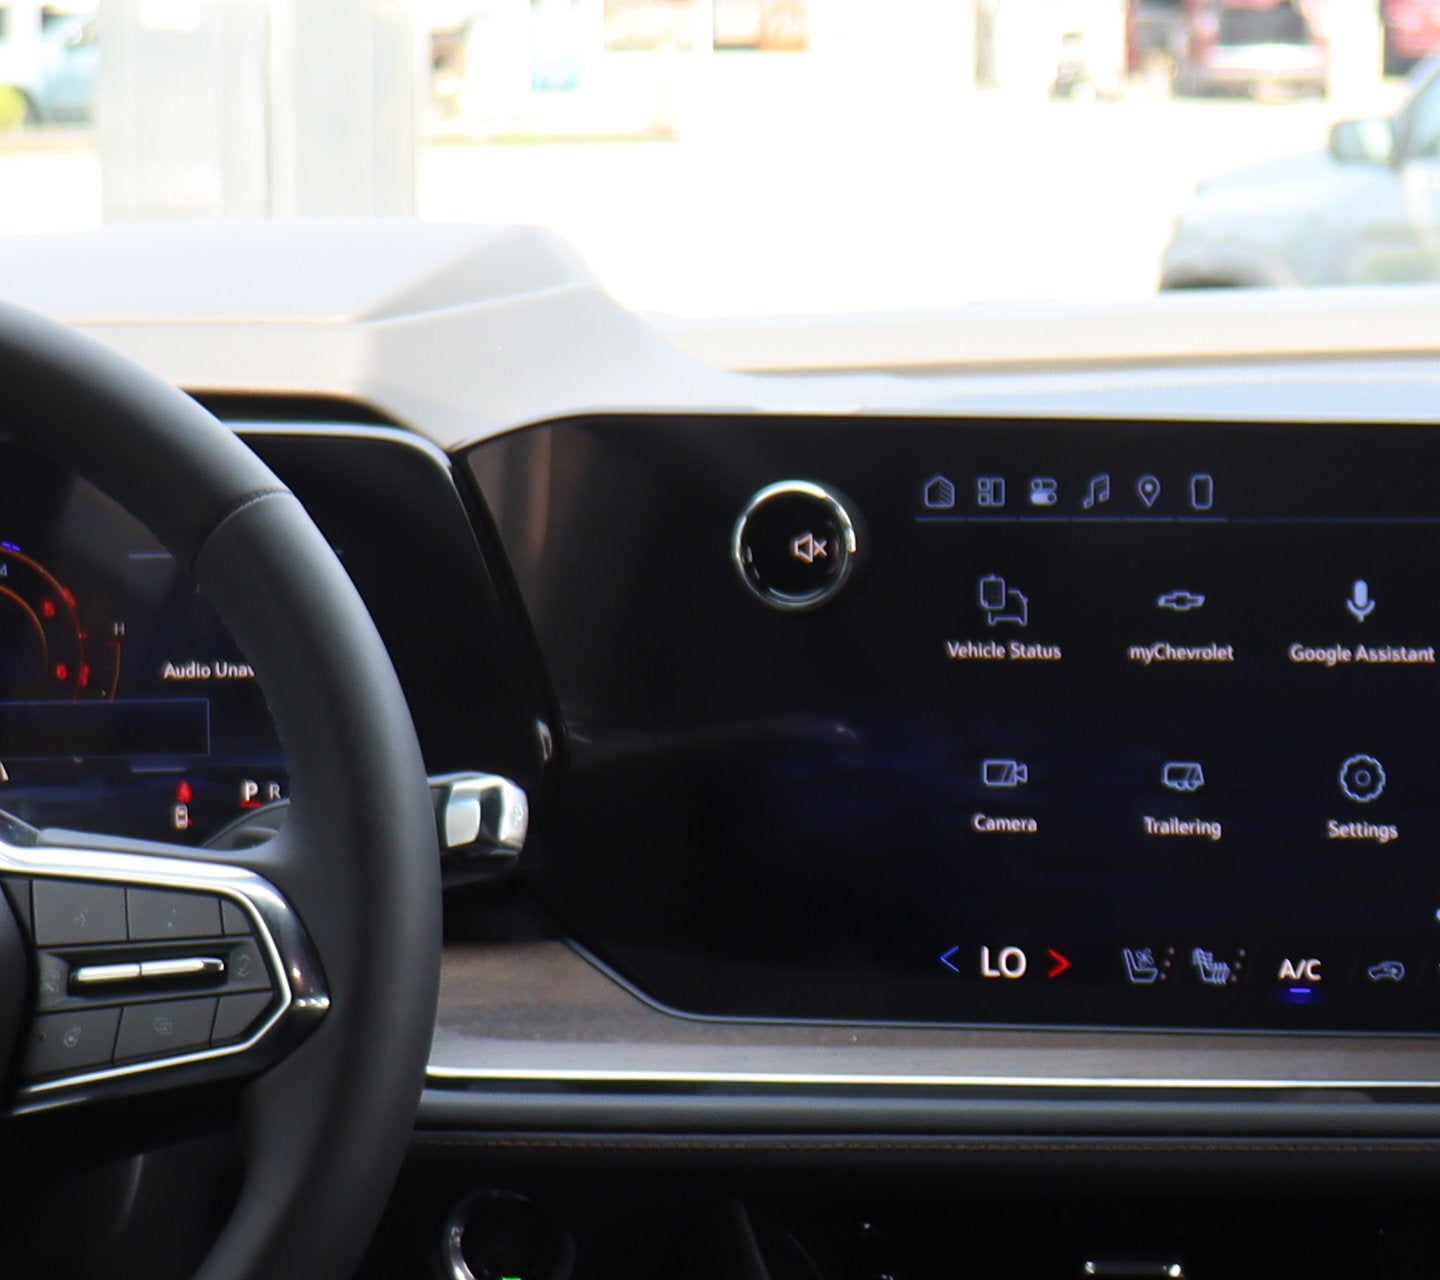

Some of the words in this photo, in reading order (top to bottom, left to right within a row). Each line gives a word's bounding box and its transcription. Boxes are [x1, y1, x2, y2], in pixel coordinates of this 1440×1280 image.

[947, 641, 1006, 659] Vehicle
[1009, 641, 1062, 660] Status
[1129, 641, 1234, 665] myChevrolet
[1289, 642, 1352, 667] Google
[1354, 644, 1436, 663] Assistant
[163, 661, 211, 679] Audio
[243, 781, 258, 803] P
[973, 812, 1038, 833] Camera
[1143, 815, 1222, 841] Trailering
[1327, 819, 1399, 844] Settings
[981, 945, 1027, 979] LO
[1279, 958, 1322, 981] A/C
